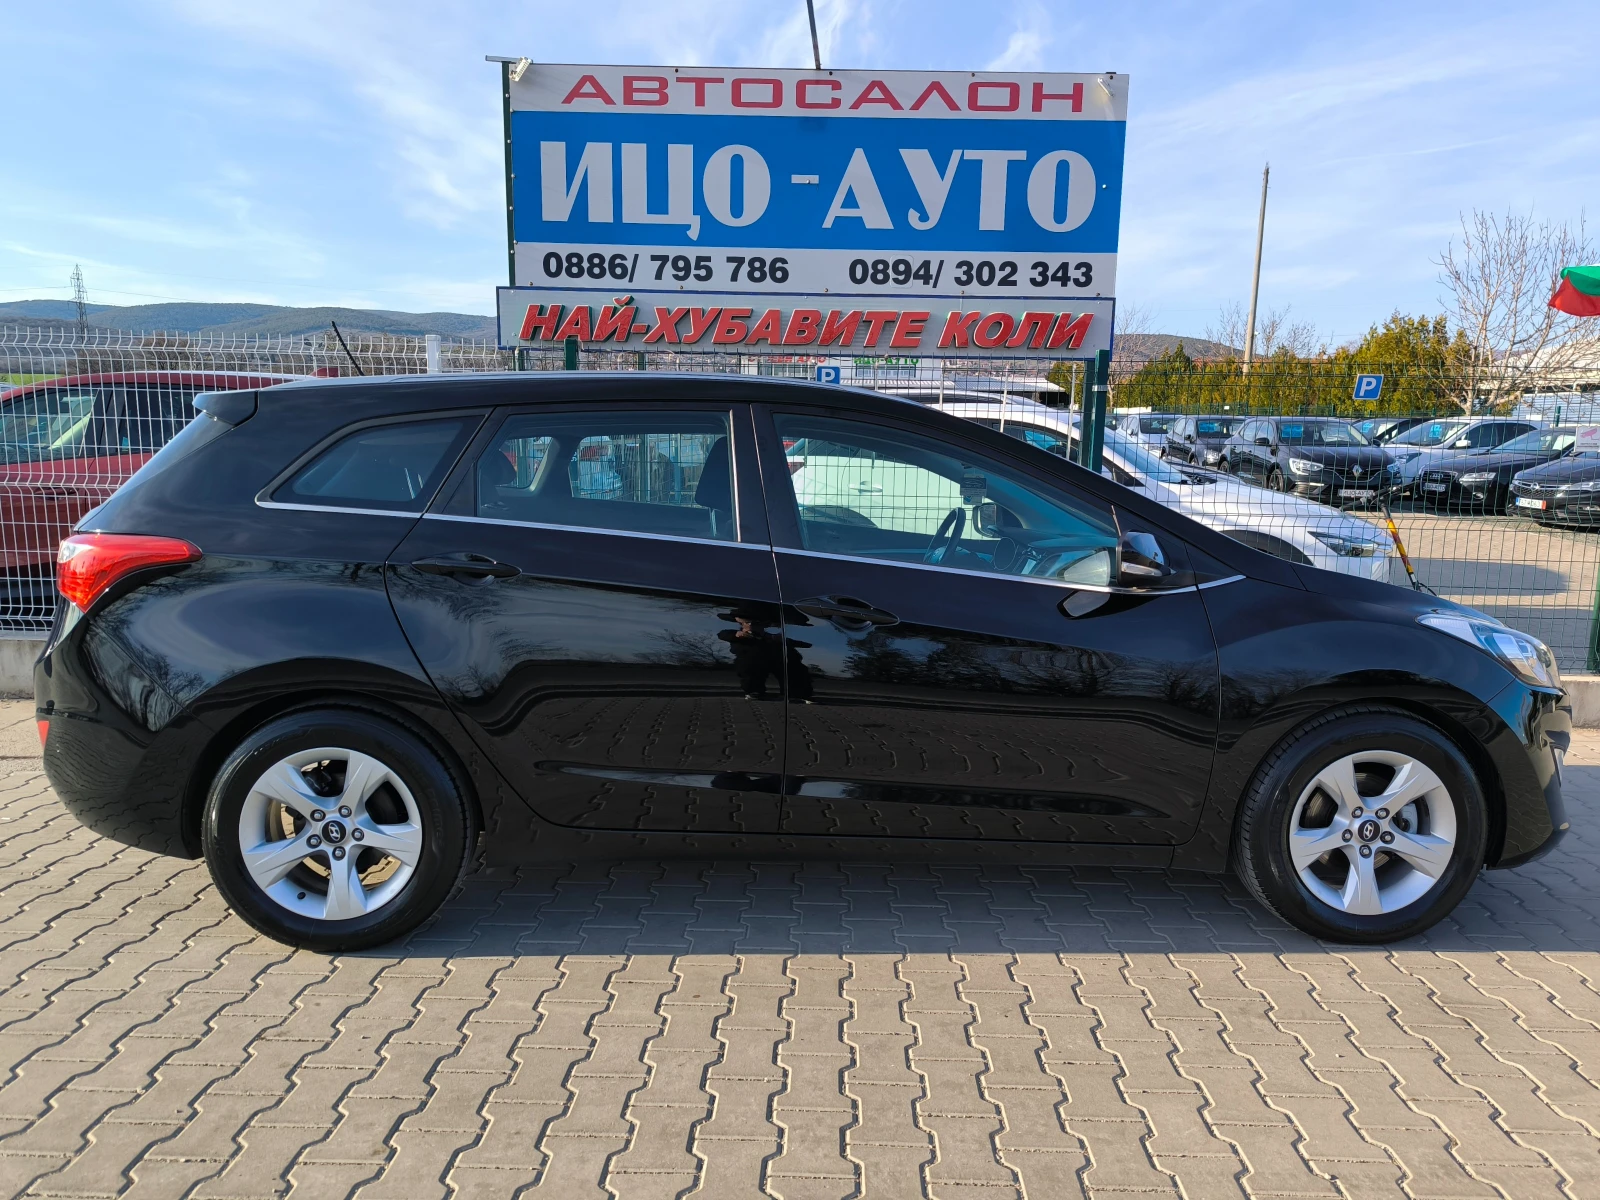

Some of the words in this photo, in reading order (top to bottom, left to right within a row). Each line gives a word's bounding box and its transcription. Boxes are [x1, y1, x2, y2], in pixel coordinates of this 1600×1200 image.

[563, 75, 1084, 113] АВТОСАЛОН
[542, 251, 640, 283] 0886/
[650, 254, 714, 282] 795
[726, 256, 790, 284] 786
[848, 258, 945, 289] 0894/
[953, 260, 1018, 287] 302
[1029, 261, 1093, 288] 343
[519, 294, 930, 348] НАЙ-ХУБАВИТЕ
[937, 310, 1094, 350] КОЛИ
[821, 368, 836, 383] P
[1359, 377, 1377, 397] P
